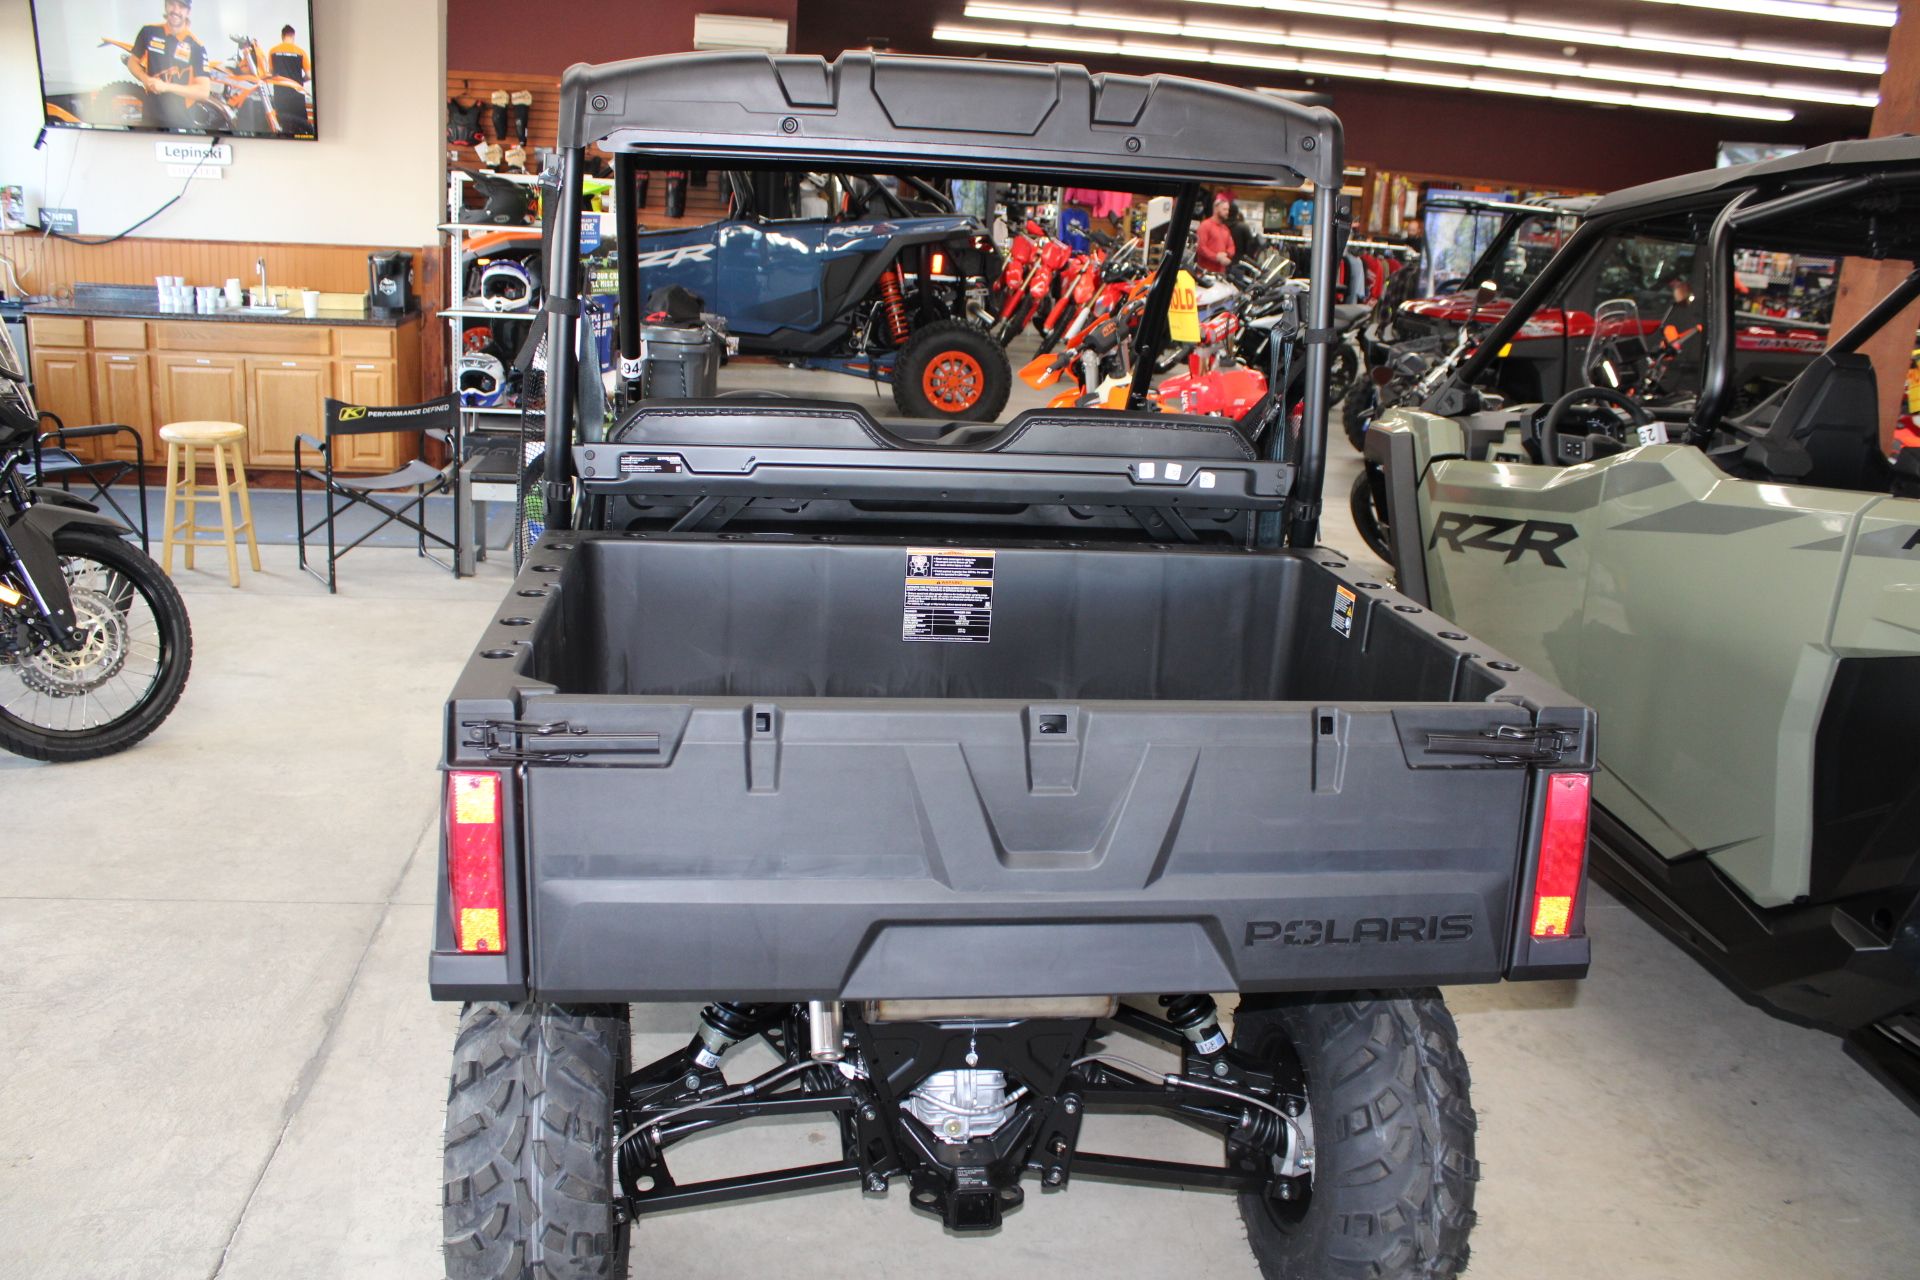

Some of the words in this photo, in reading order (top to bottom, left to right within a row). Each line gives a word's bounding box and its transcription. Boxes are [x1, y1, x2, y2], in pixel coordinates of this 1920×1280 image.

[164, 145, 222, 160] Lepinski
[638, 243, 717, 269] ZR
[1171, 287, 1194, 310] OLD
[368, 408, 421, 417] PERFORMANCE
[422, 404, 449, 414] DEFINED
[1428, 511, 1579, 569] RZR
[1244, 914, 1474, 947] POLARIS
